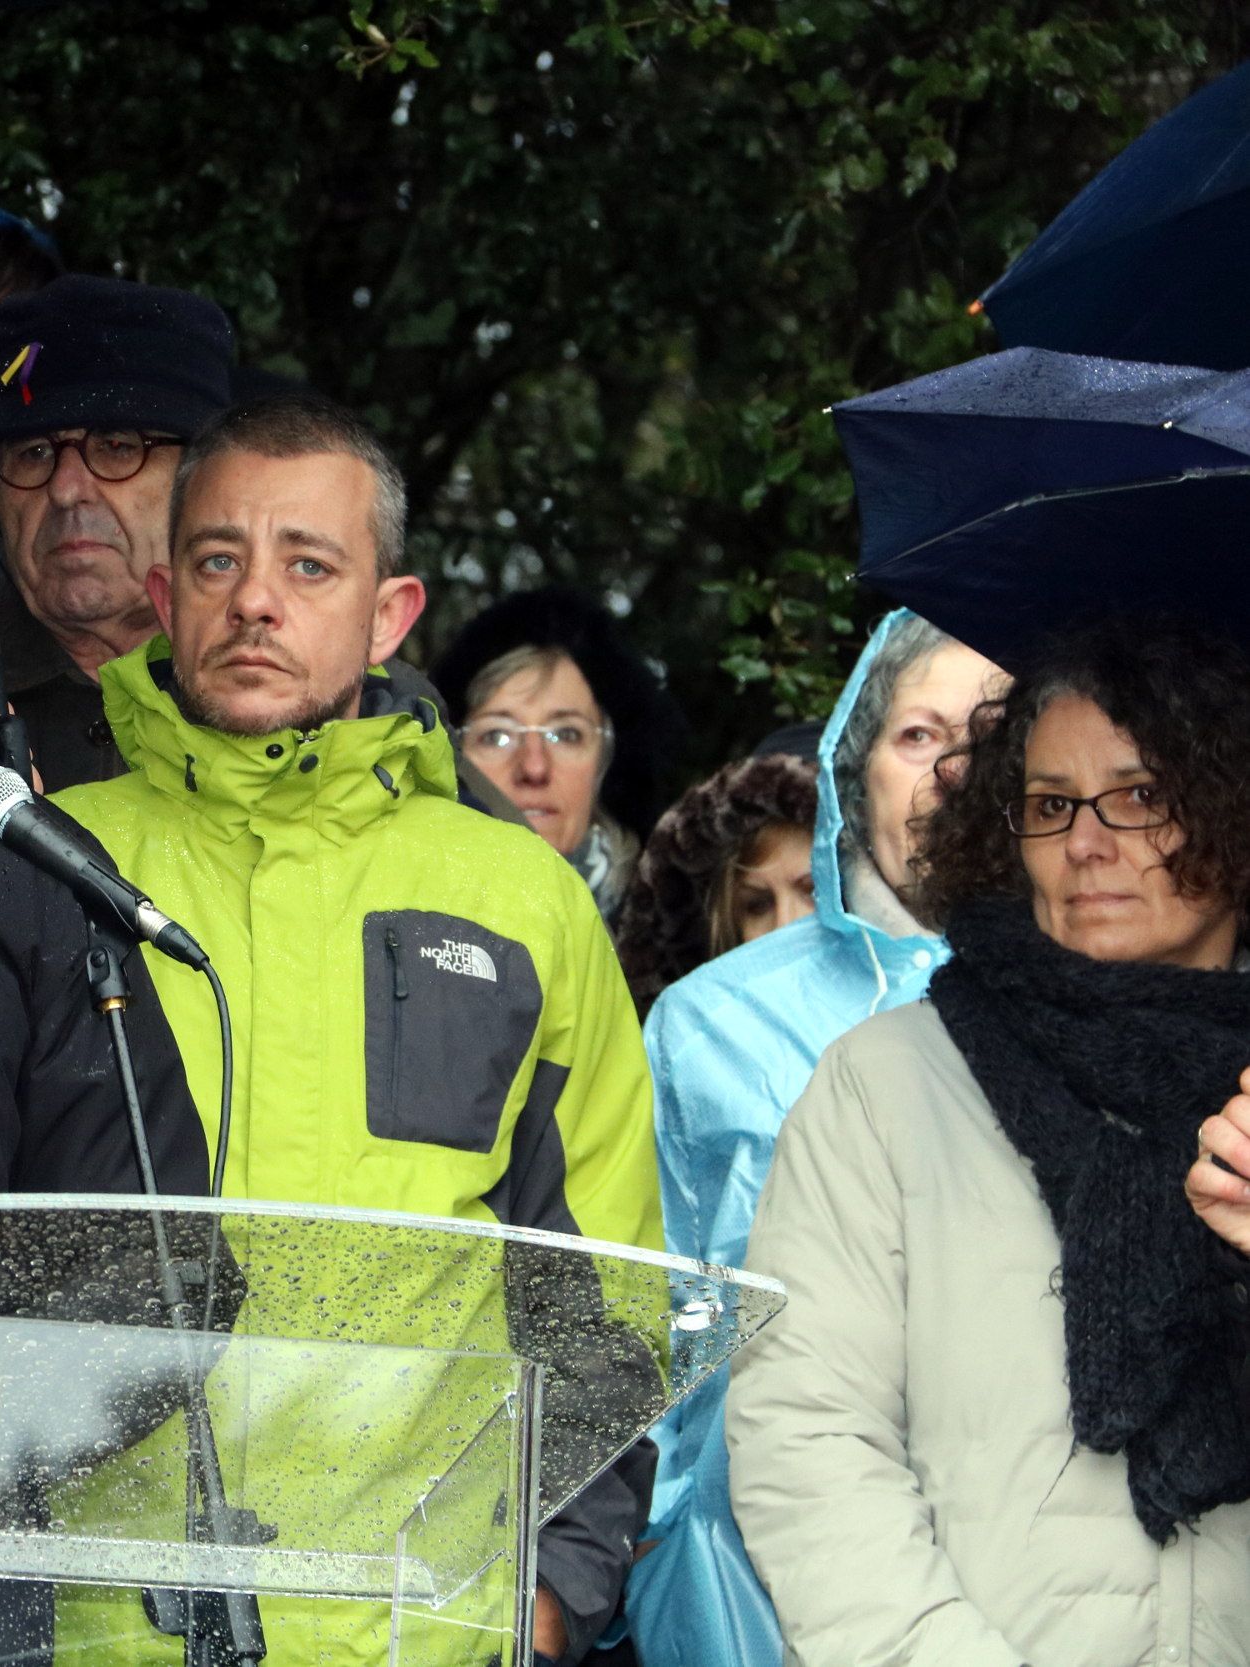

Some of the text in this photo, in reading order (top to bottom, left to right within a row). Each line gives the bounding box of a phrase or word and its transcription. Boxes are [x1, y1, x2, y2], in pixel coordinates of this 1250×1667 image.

[442, 939, 471, 954] THE
[421, 947, 471, 965] NORTH
[437, 958, 473, 976] FACE
